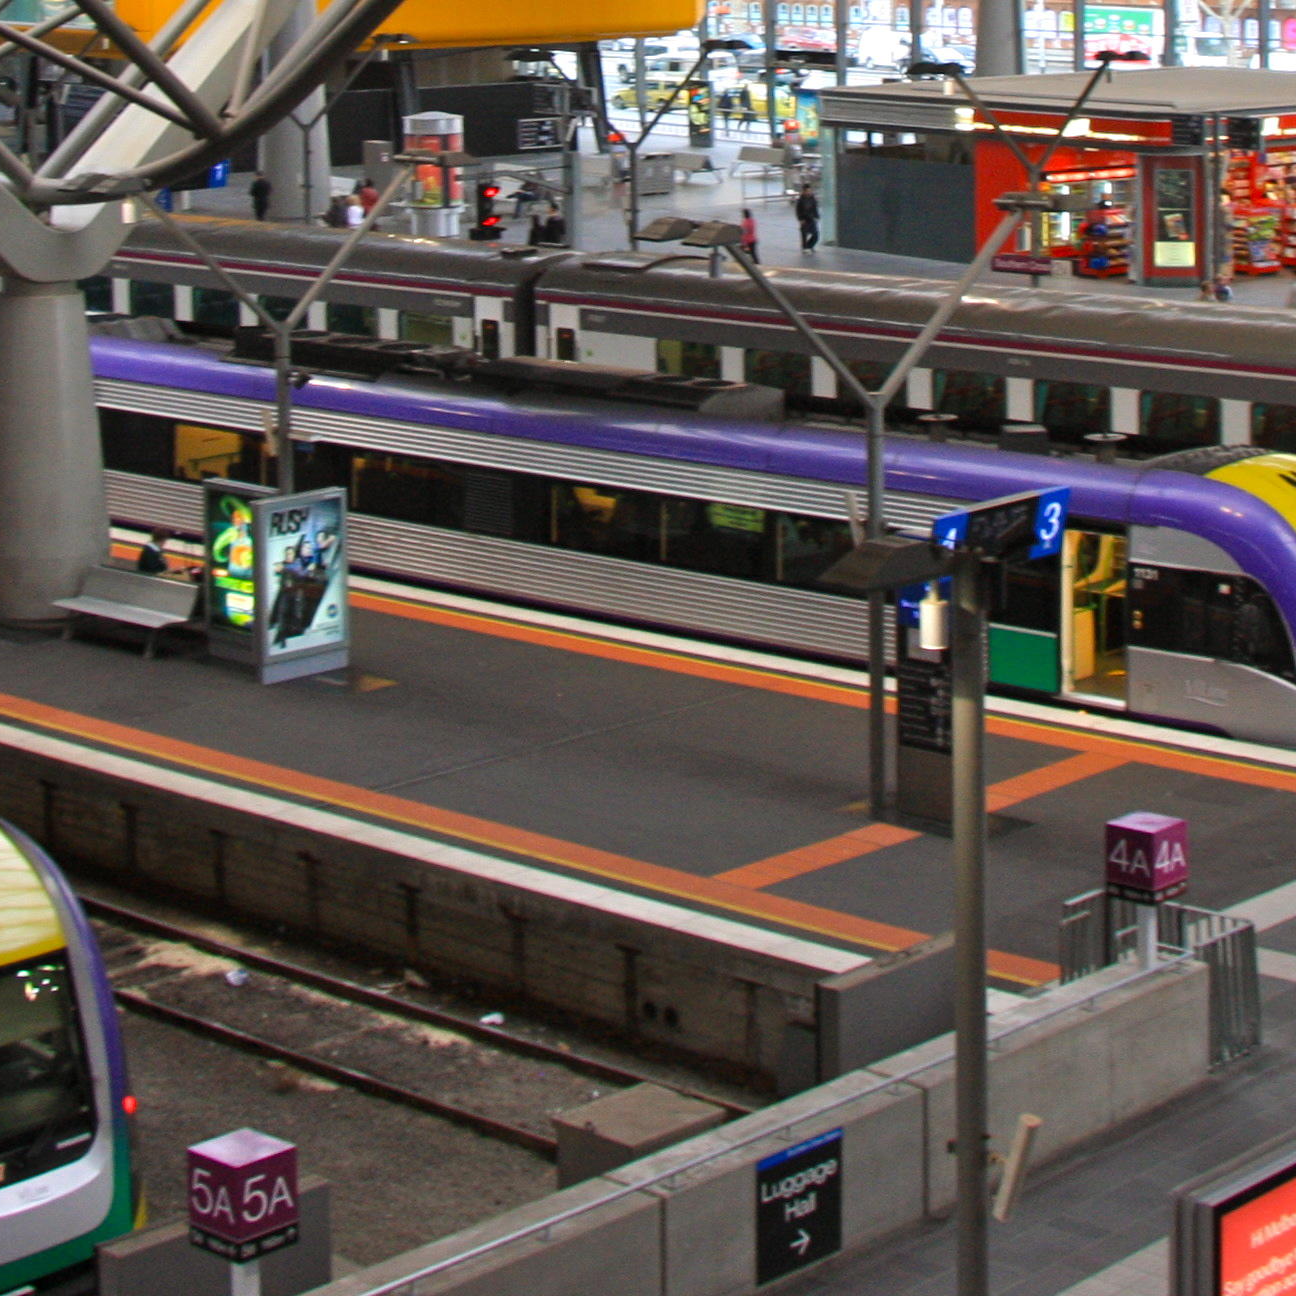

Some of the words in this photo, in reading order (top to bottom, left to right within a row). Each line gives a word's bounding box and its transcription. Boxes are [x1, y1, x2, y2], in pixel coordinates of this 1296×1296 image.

[1040, 502, 1062, 541] 3
[1109, 838, 1151, 878] 4A
[1154, 839, 1187, 873] 4A
[191, 1167, 235, 1224] 5A
[242, 1173, 294, 1223] 5A
[760, 1159, 838, 1204] Luggage
[784, 1191, 817, 1222] Hall
